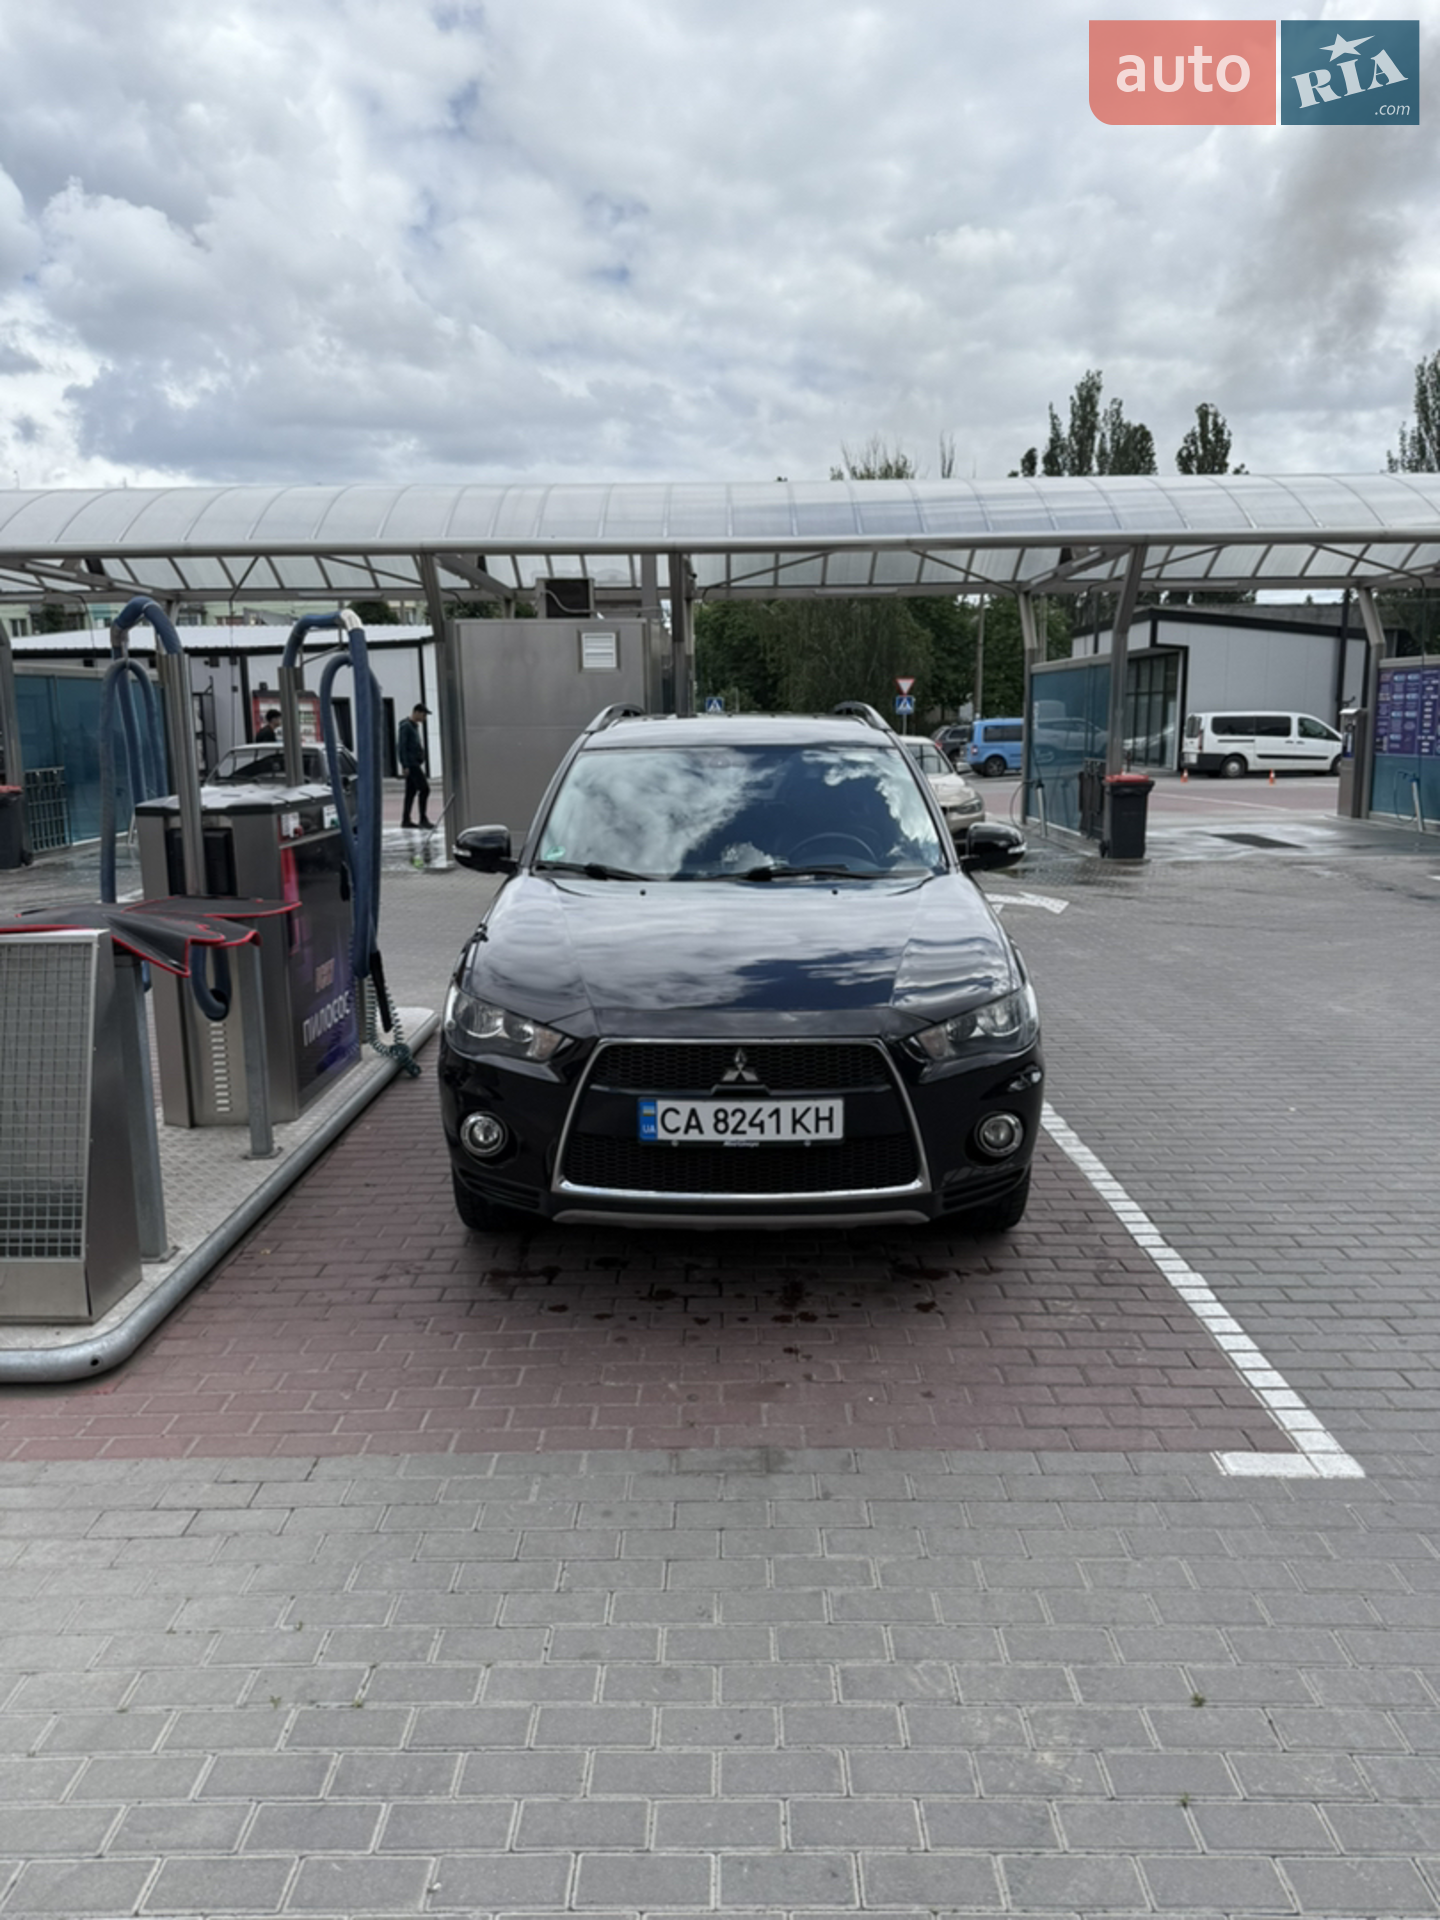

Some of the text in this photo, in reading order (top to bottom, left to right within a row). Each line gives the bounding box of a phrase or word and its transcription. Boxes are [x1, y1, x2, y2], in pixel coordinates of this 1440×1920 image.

[642, 1124, 656, 1134] UA
[660, 1106, 834, 1135] CA 8241 KH
